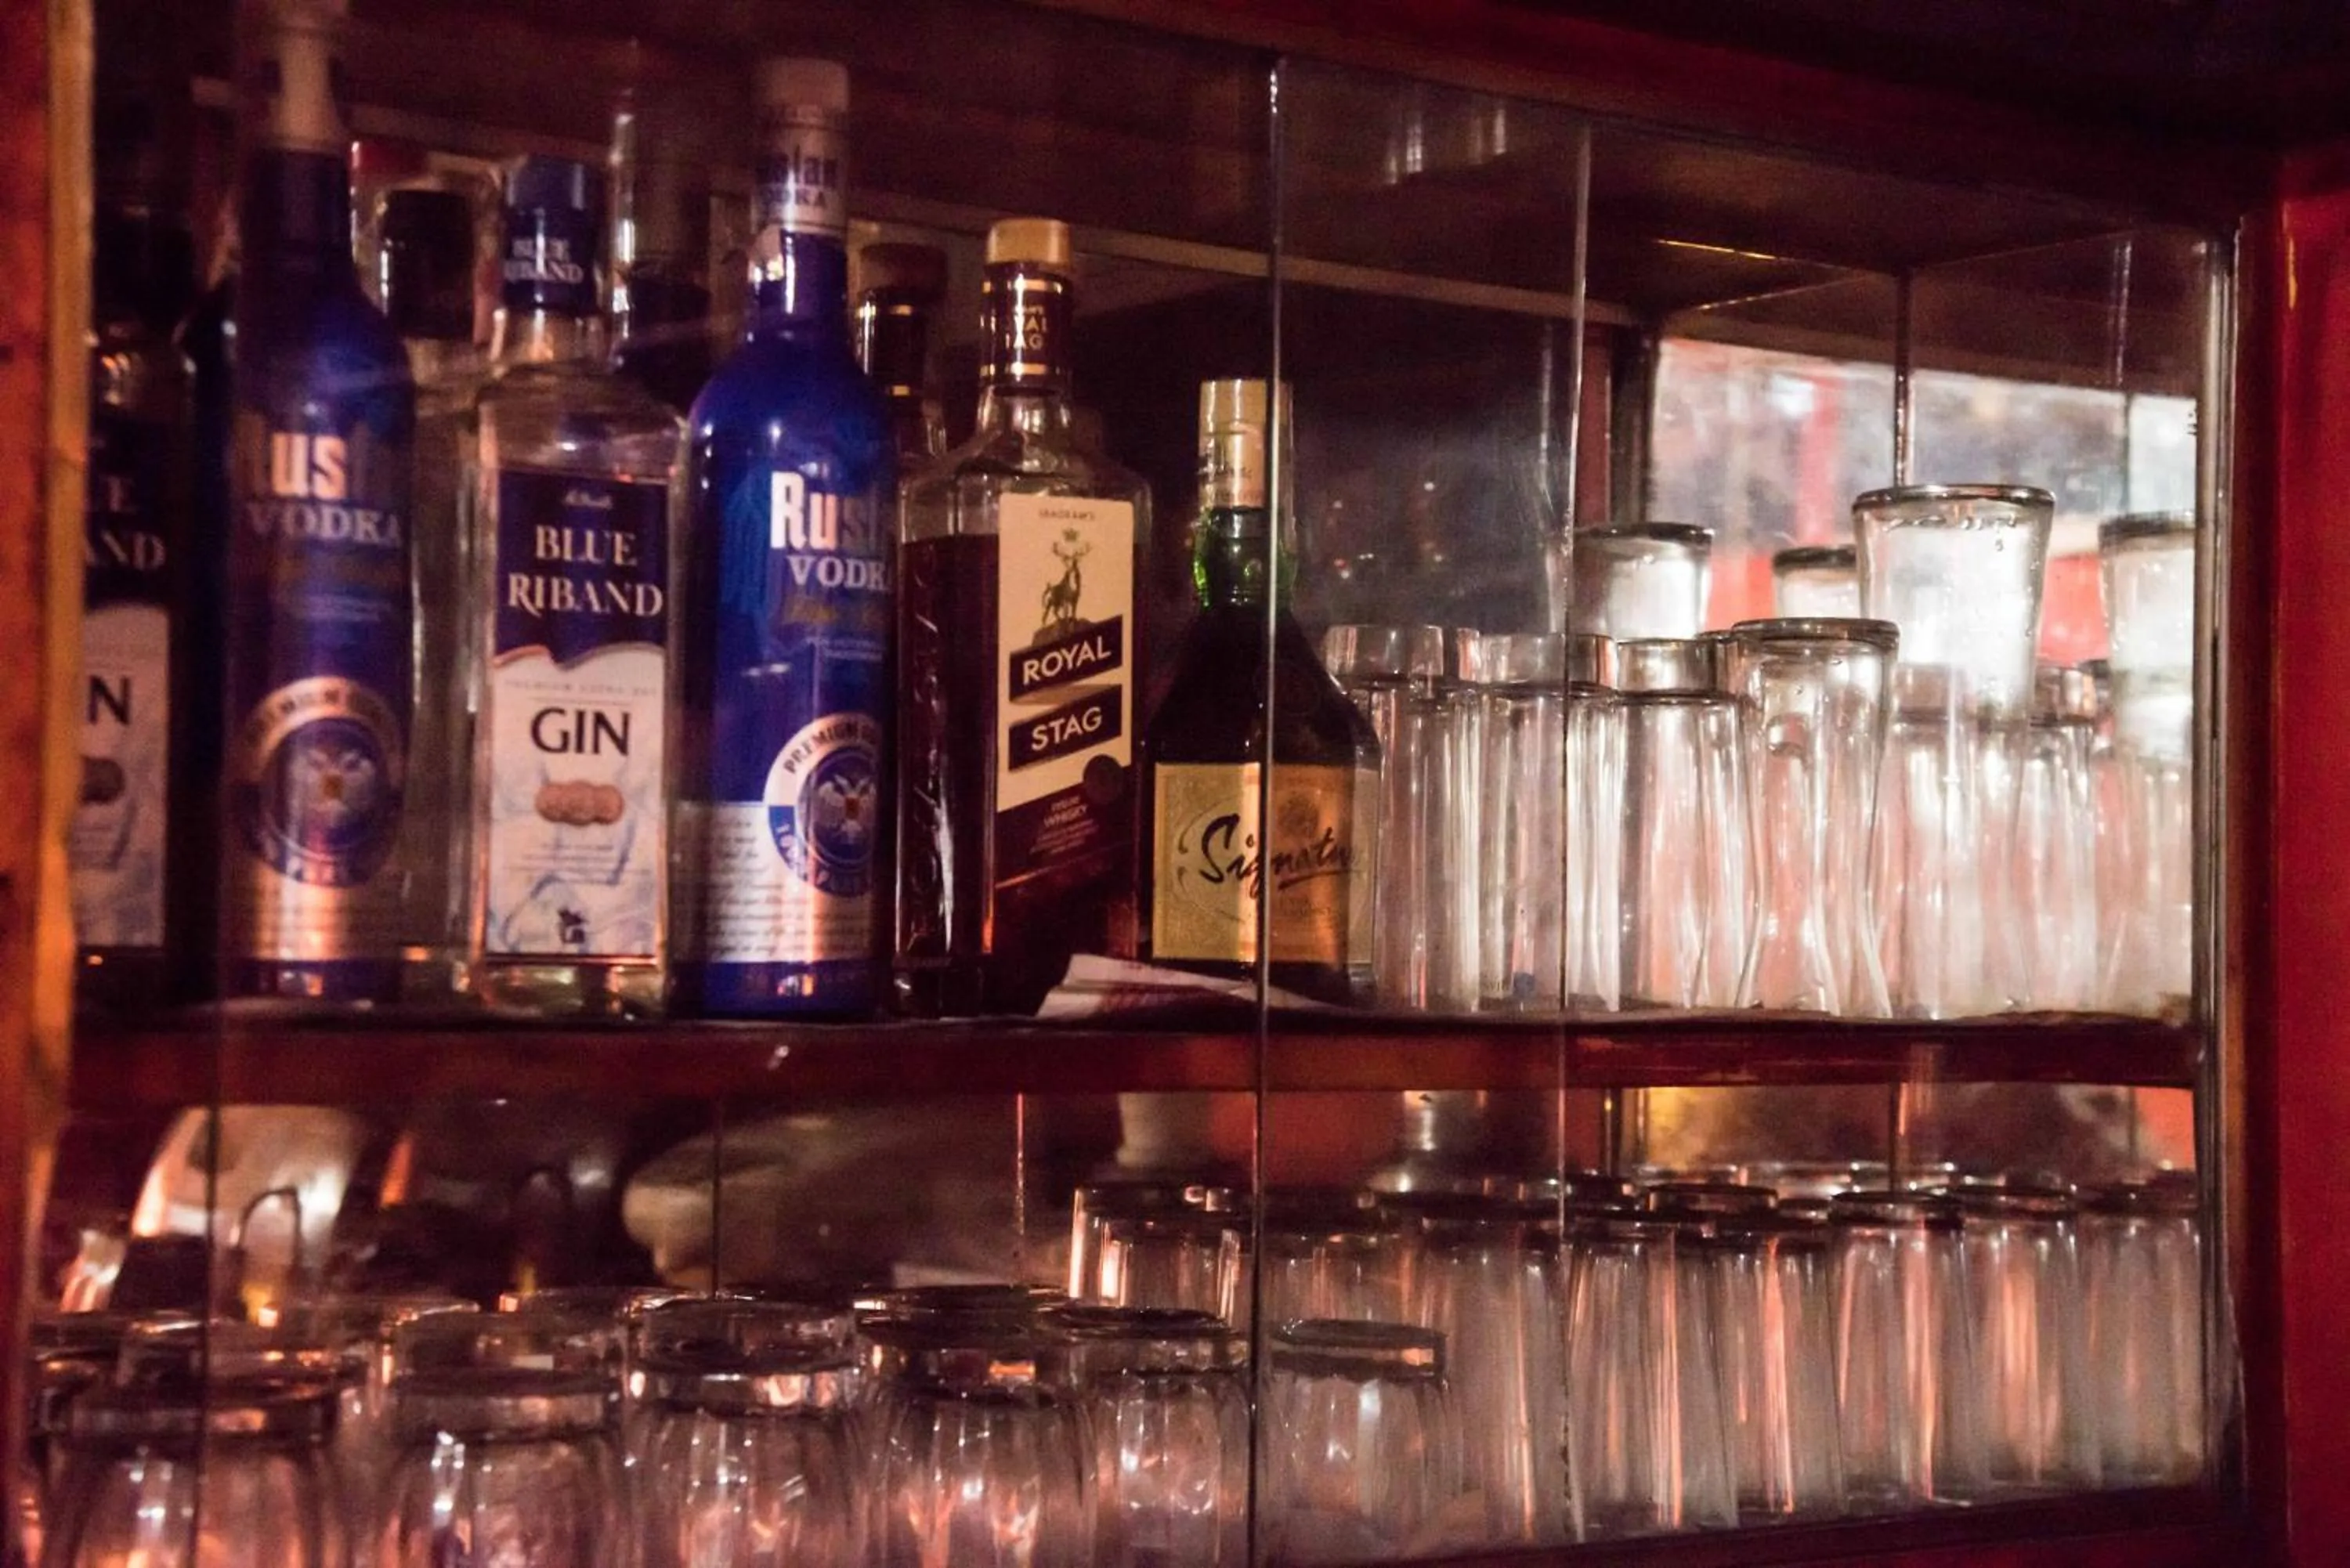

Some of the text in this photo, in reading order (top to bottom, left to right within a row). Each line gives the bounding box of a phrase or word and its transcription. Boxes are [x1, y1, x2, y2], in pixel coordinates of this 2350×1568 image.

[535, 524, 638, 567] BLUE
[508, 573, 663, 618] RIBAND
[787, 555, 890, 591] VODK
[1022, 635, 1112, 686] ROYAL
[530, 706, 631, 757] GIN
[1031, 706, 1103, 751] STAG
